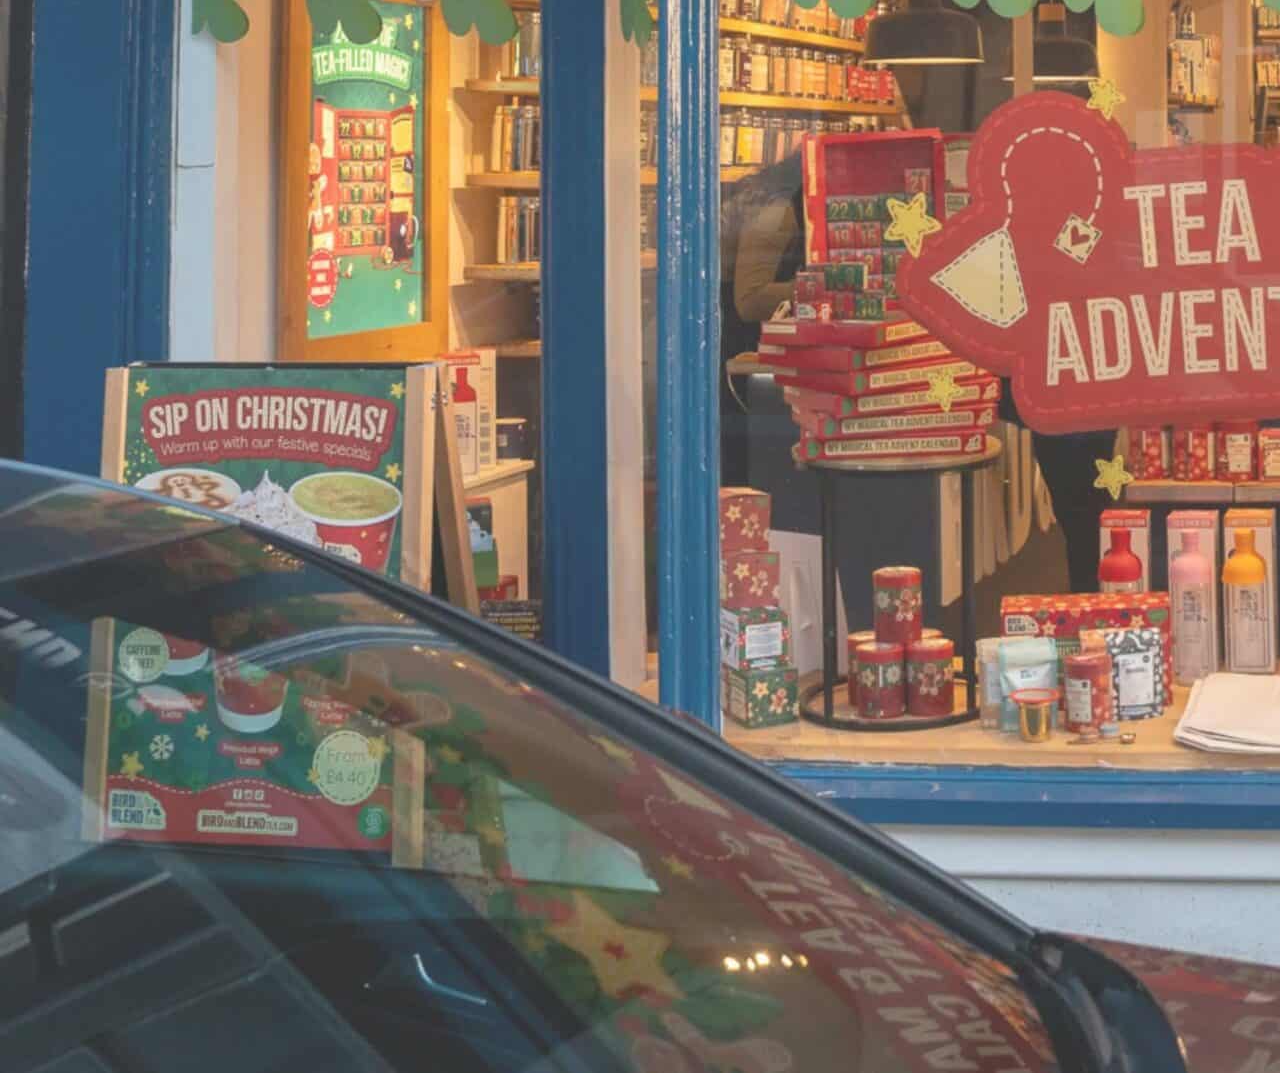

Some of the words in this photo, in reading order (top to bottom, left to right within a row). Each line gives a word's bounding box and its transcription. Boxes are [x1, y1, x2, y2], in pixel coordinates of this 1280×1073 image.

[1123, 177, 1262, 270] TEA
[149, 401, 188, 439] SIP
[195, 397, 229, 432] ON
[236, 395, 388, 443] CHRISTMAS!
[160, 438, 201, 456] Warm
[203, 438, 219, 452] up
[222, 434, 250, 450] with
[251, 436, 274, 450] our
[277, 434, 320, 453] festive
[322, 443, 372, 462] specials
